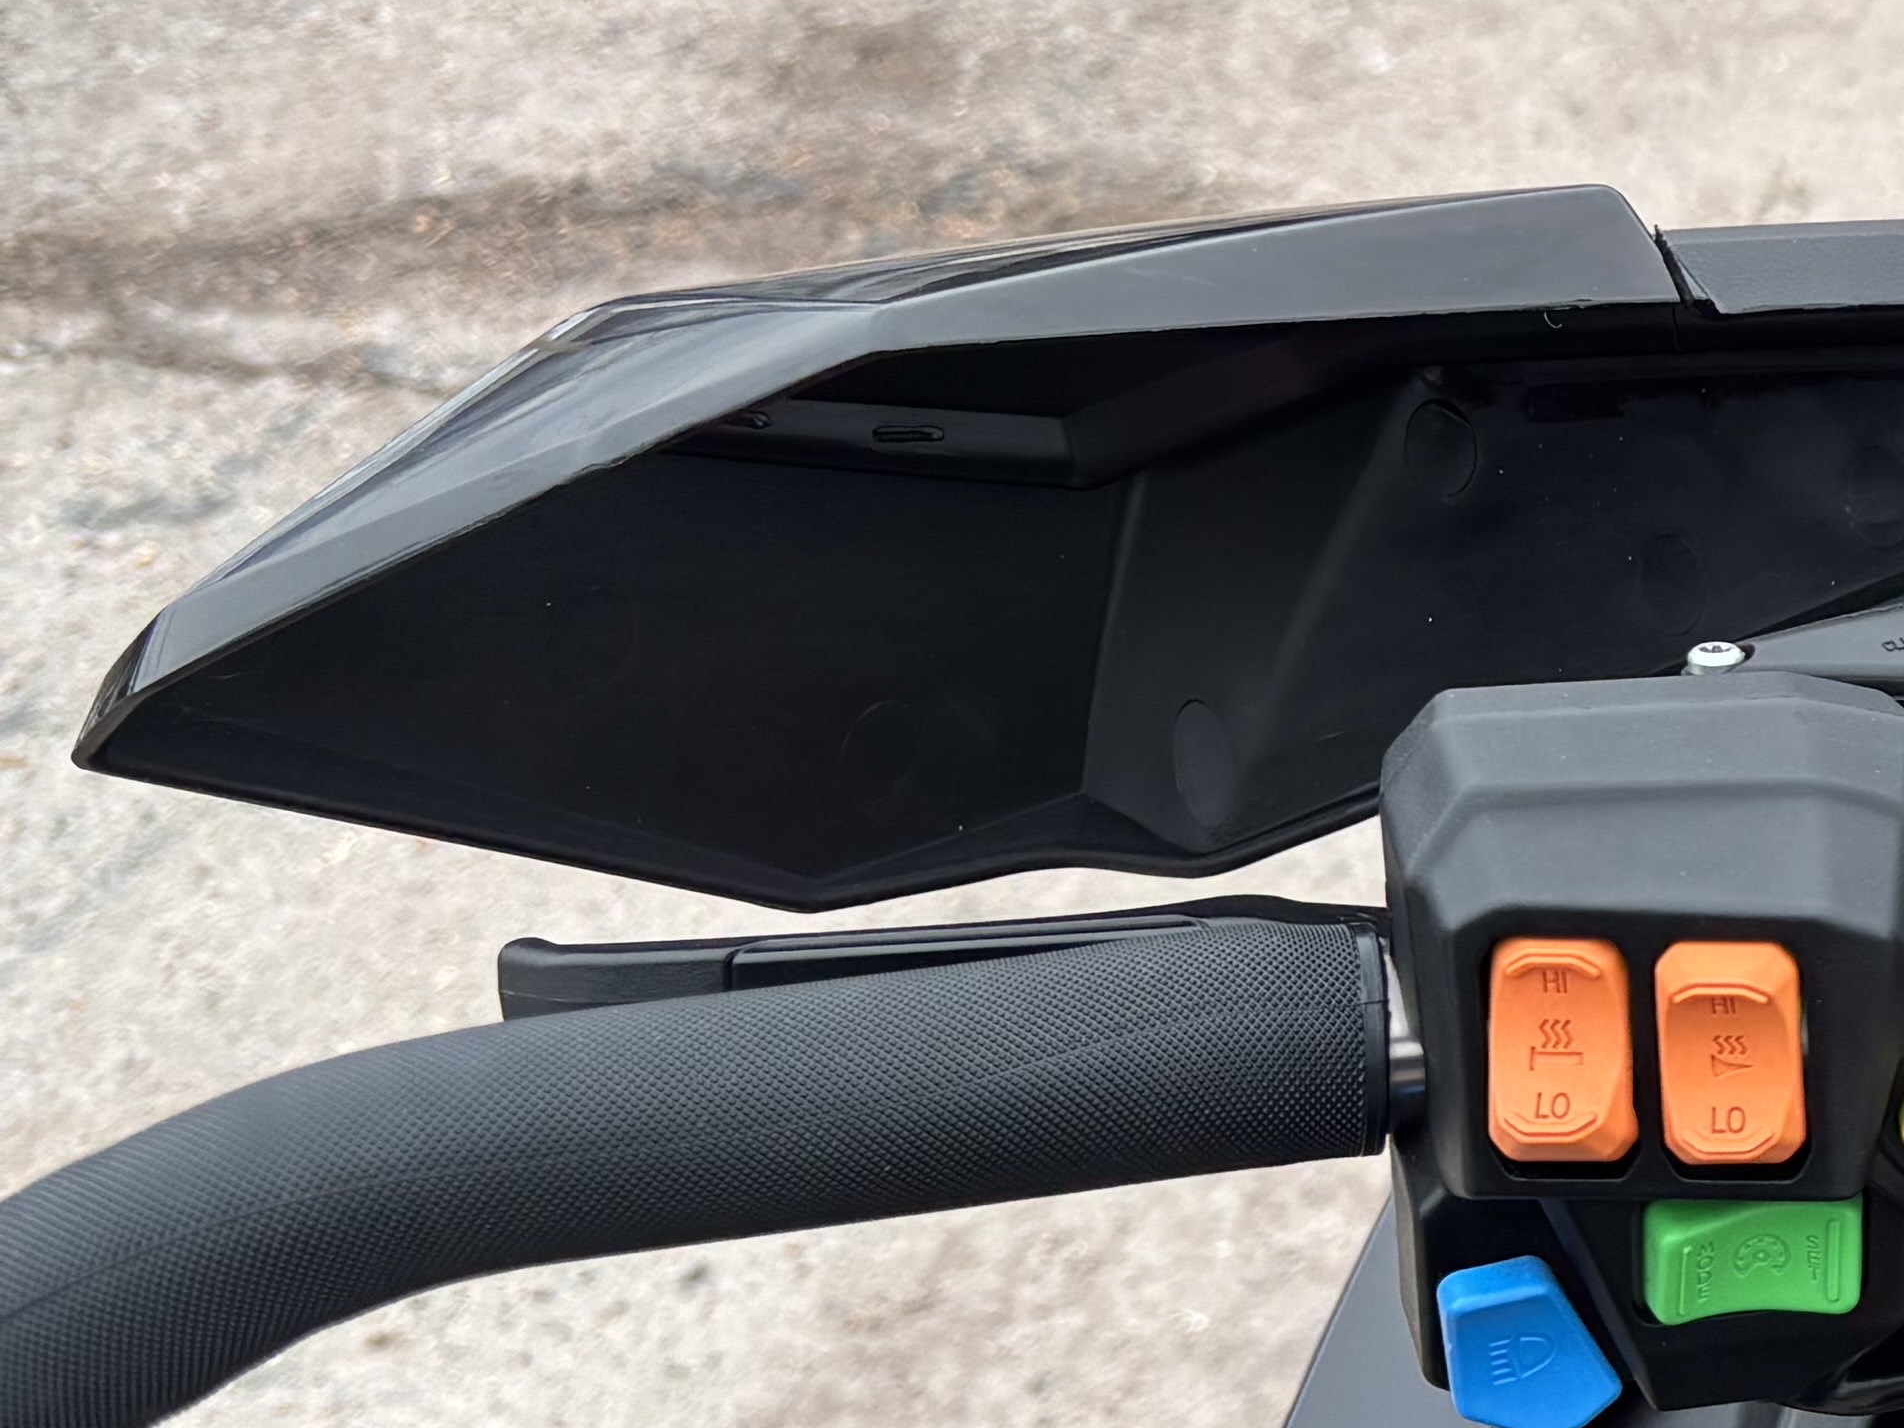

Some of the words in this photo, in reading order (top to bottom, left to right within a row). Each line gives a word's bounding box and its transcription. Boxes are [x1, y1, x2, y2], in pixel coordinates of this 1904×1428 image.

[1542, 970, 1569, 995] HI
[1710, 996, 1738, 1016] HI
[1534, 1091, 1572, 1120] LO
[1710, 1105, 1747, 1135] LO
